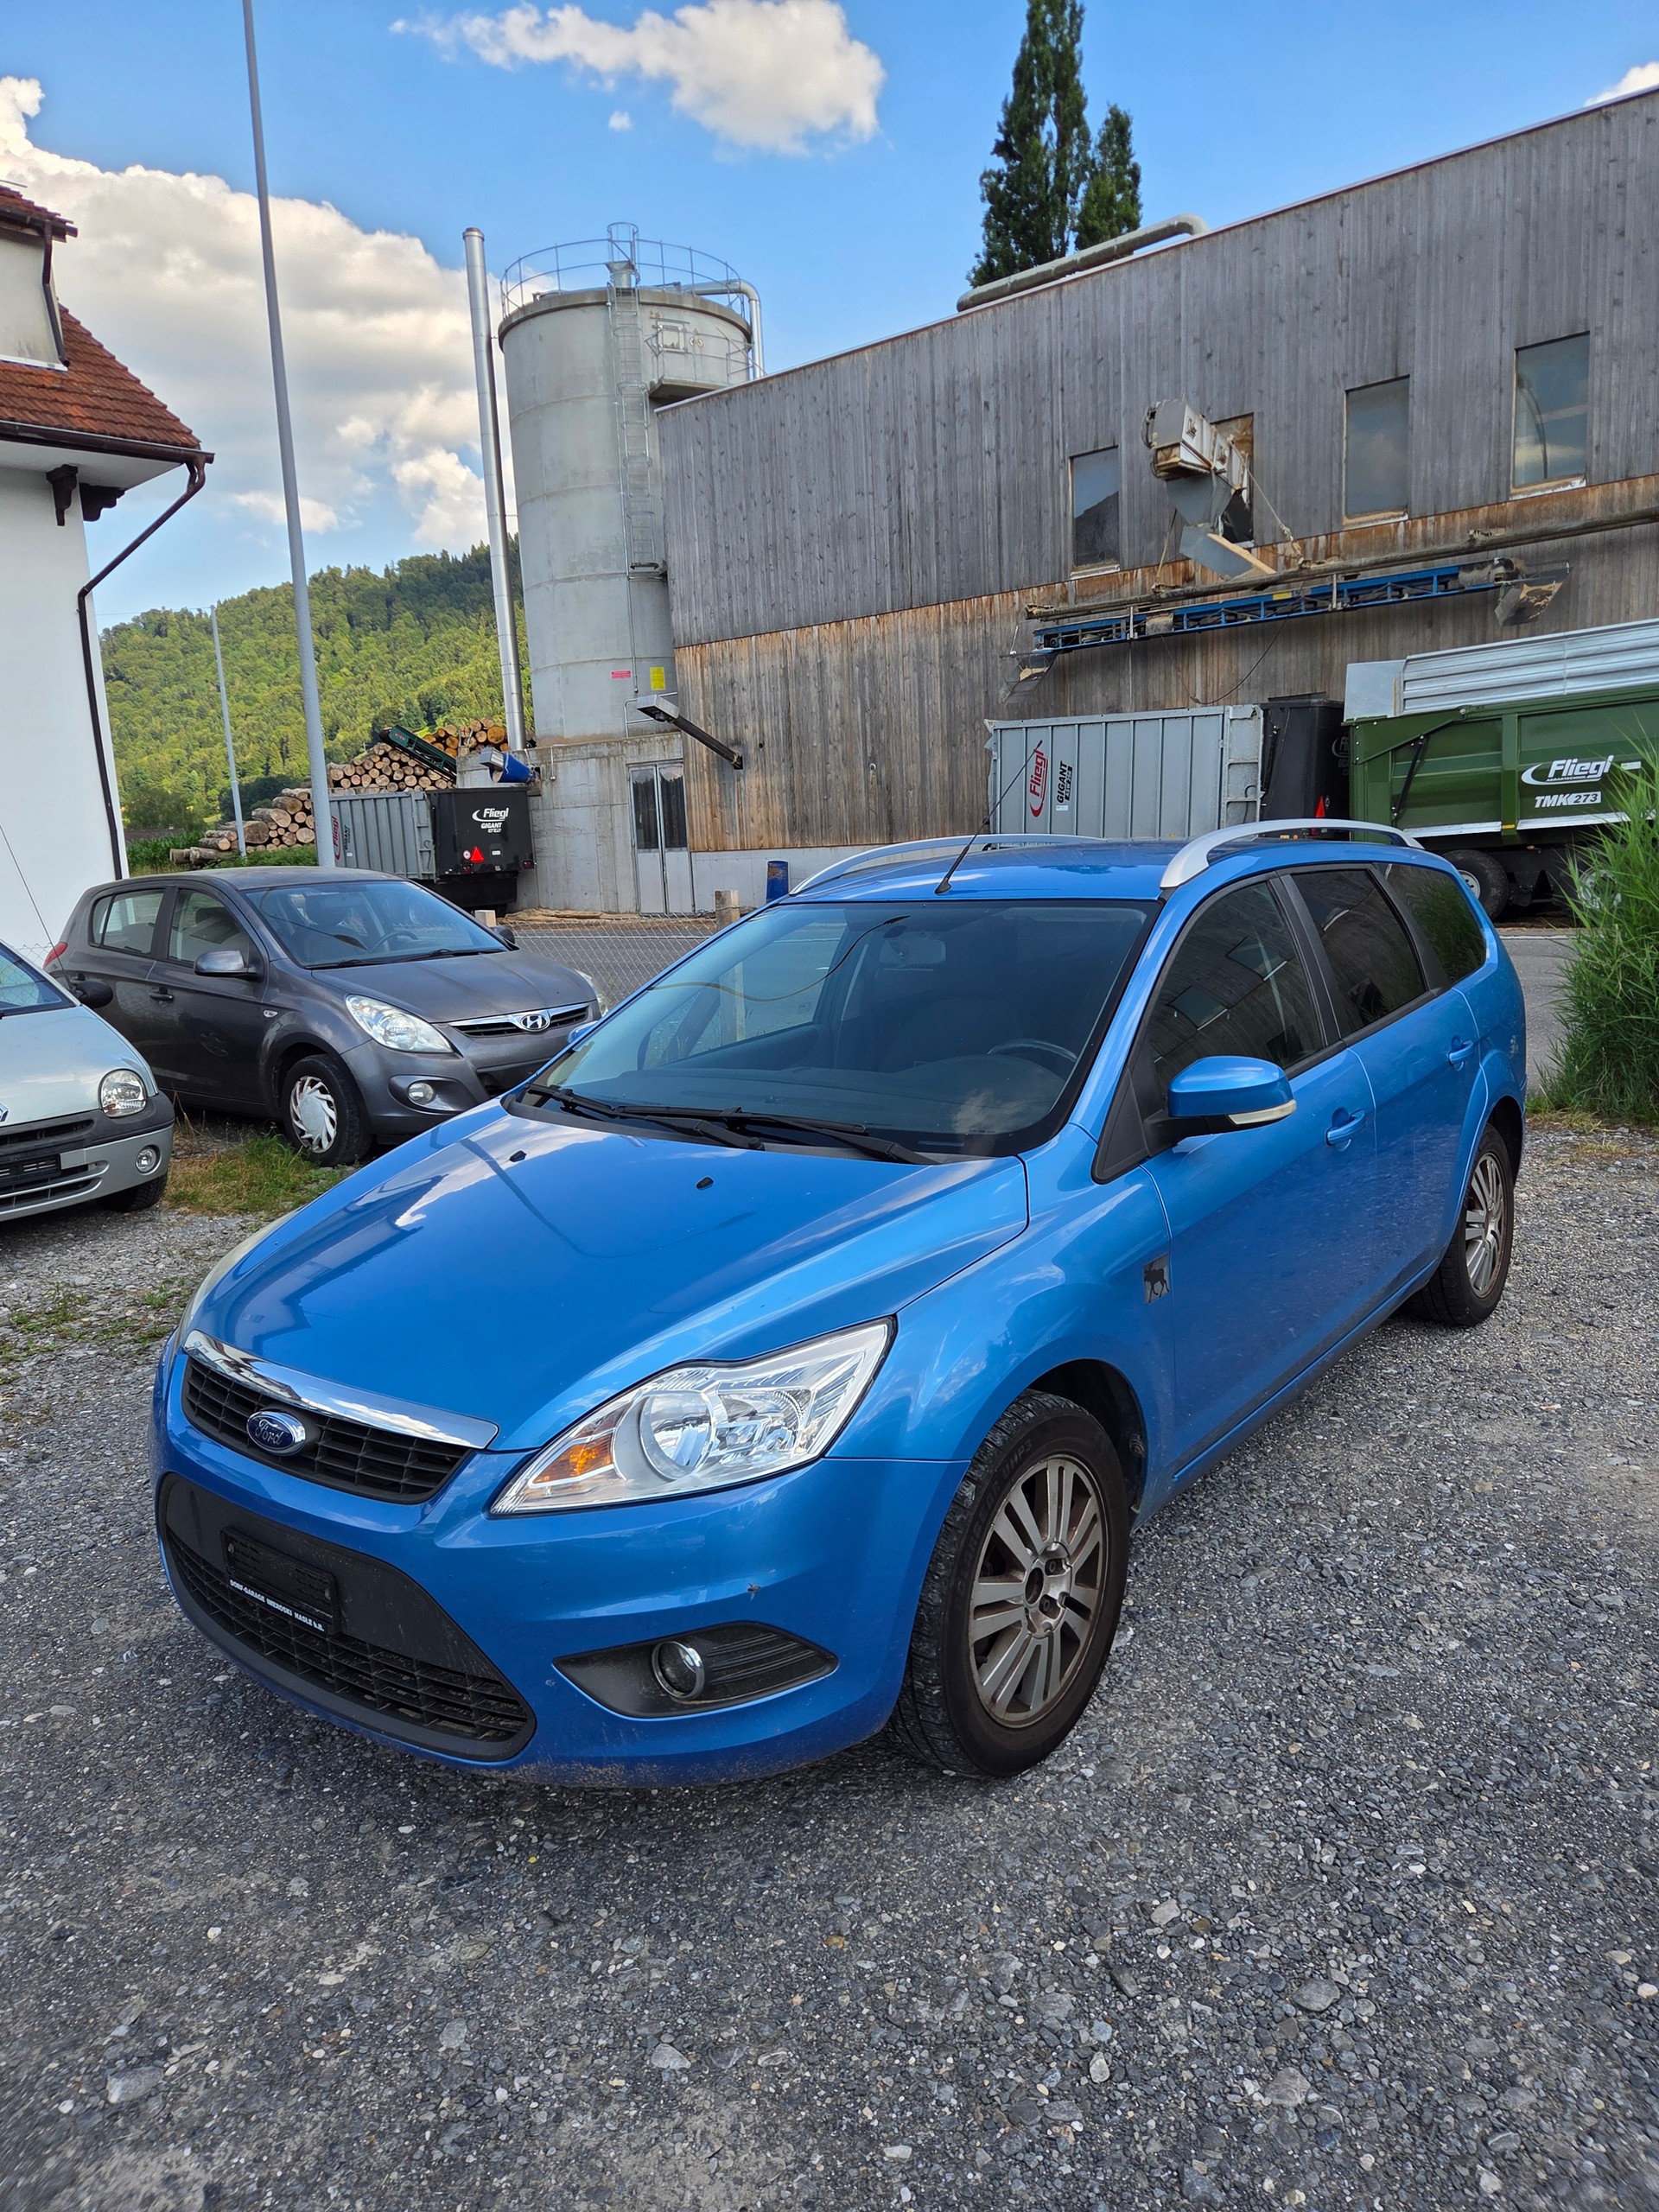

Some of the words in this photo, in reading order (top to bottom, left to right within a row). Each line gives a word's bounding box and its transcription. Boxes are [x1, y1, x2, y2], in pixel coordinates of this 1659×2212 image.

[1029, 748, 1046, 797] Fliegl
[1547, 755, 1614, 778] Fliegl
[1057, 761, 1068, 804] GIGANT
[1535, 794, 1570, 808] TMK
[1573, 793, 1598, 804] 273
[483, 808, 509, 820] Fliegl
[255, 1419, 284, 1446] Ford
[1002, 1438, 1032, 1479] UHP3
[230, 1580, 265, 1603] DORF-GARAGE
